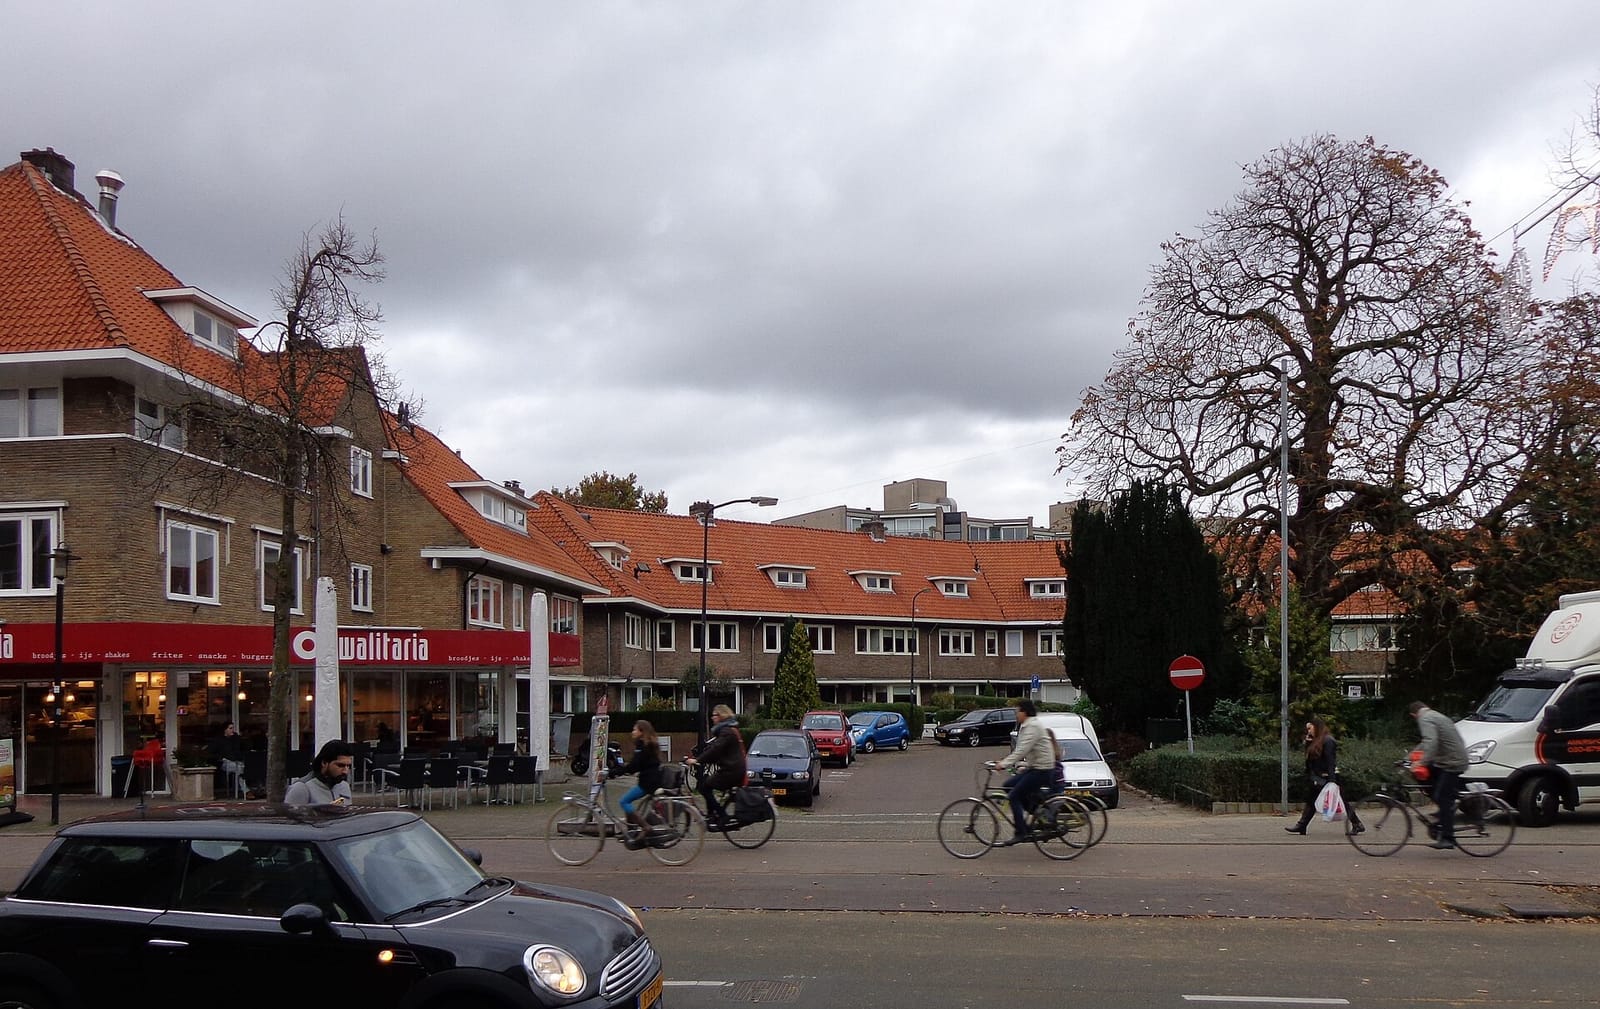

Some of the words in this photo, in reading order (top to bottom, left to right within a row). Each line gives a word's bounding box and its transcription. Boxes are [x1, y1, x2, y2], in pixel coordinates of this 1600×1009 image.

[339, 632, 429, 661] walitaria
[152, 651, 184, 659] frites
[448, 655, 480, 663] broodjes
[490, 655, 502, 663] ijs
